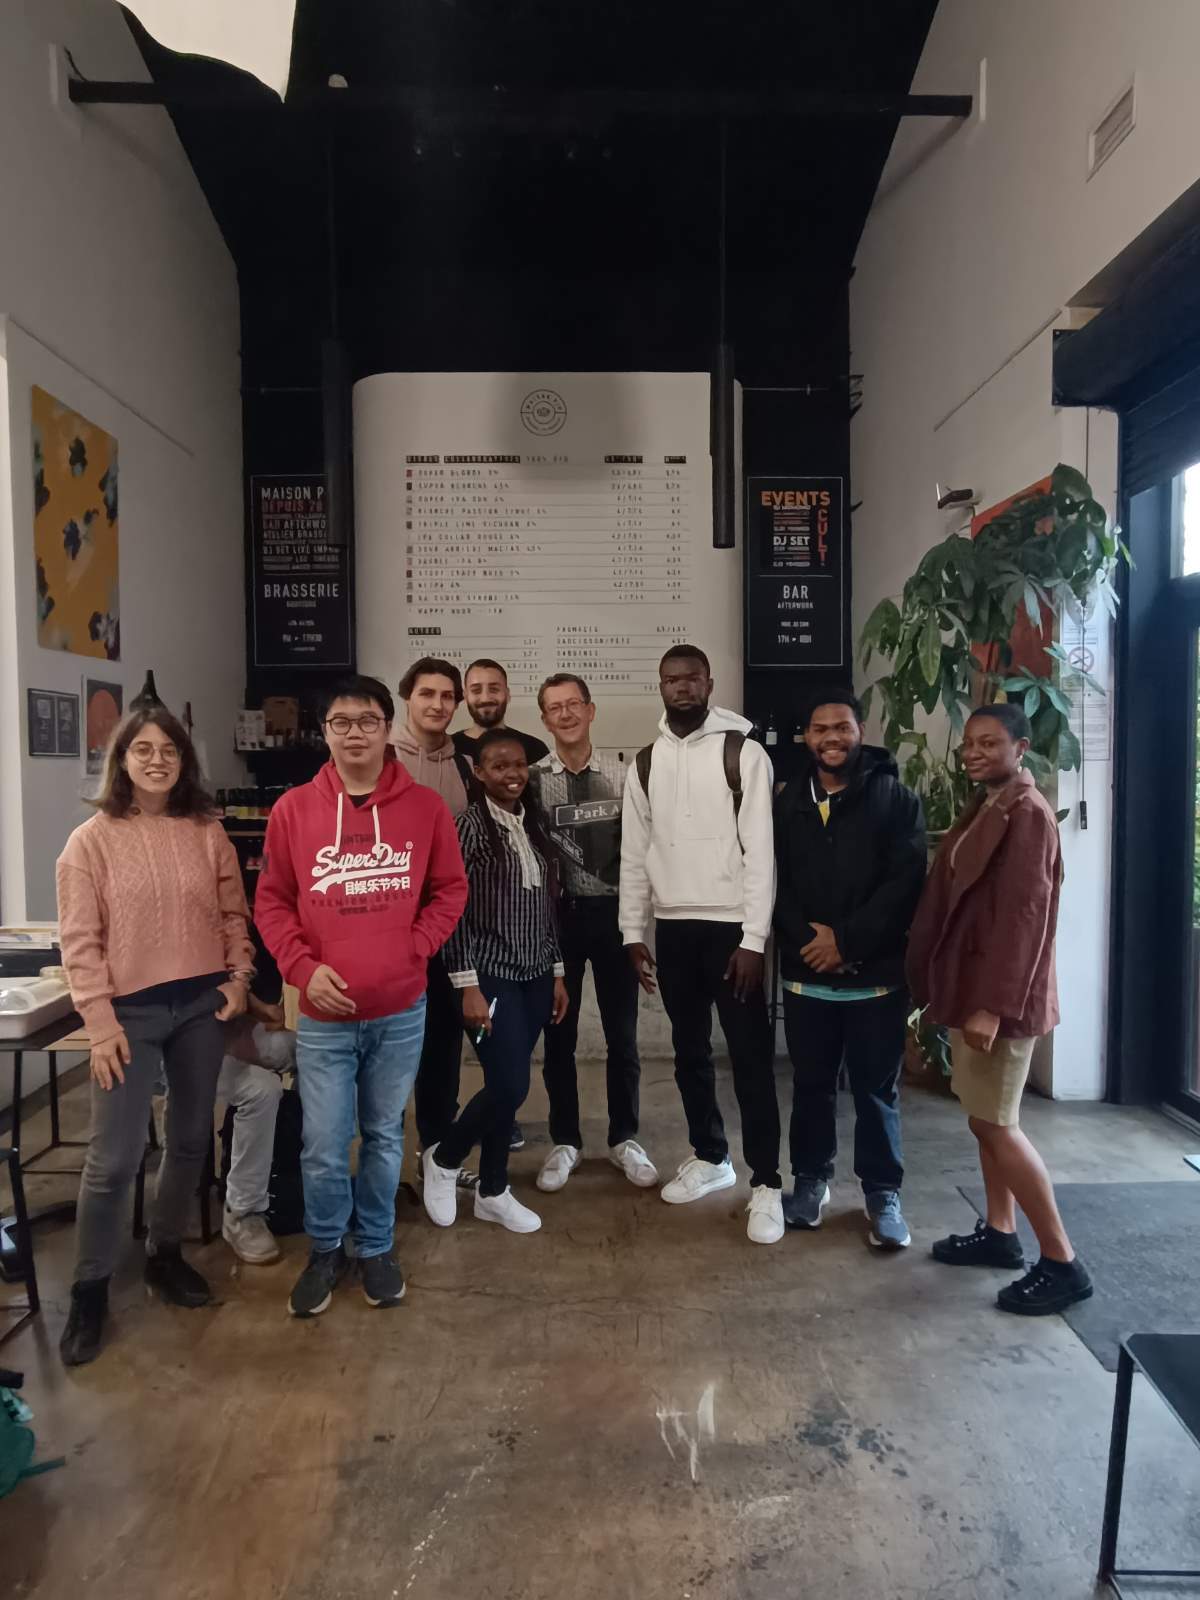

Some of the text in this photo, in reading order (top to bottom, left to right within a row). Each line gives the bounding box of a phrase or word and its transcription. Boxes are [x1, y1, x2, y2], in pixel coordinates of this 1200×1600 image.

[261, 487, 311, 500] MAISON
[761, 490, 831, 507] EVENTS
[773, 536, 811, 546] DJ SET
[264, 583, 340, 598] BRASSERIE
[783, 585, 809, 599] BAR
[573, 805, 608, 820] Park
